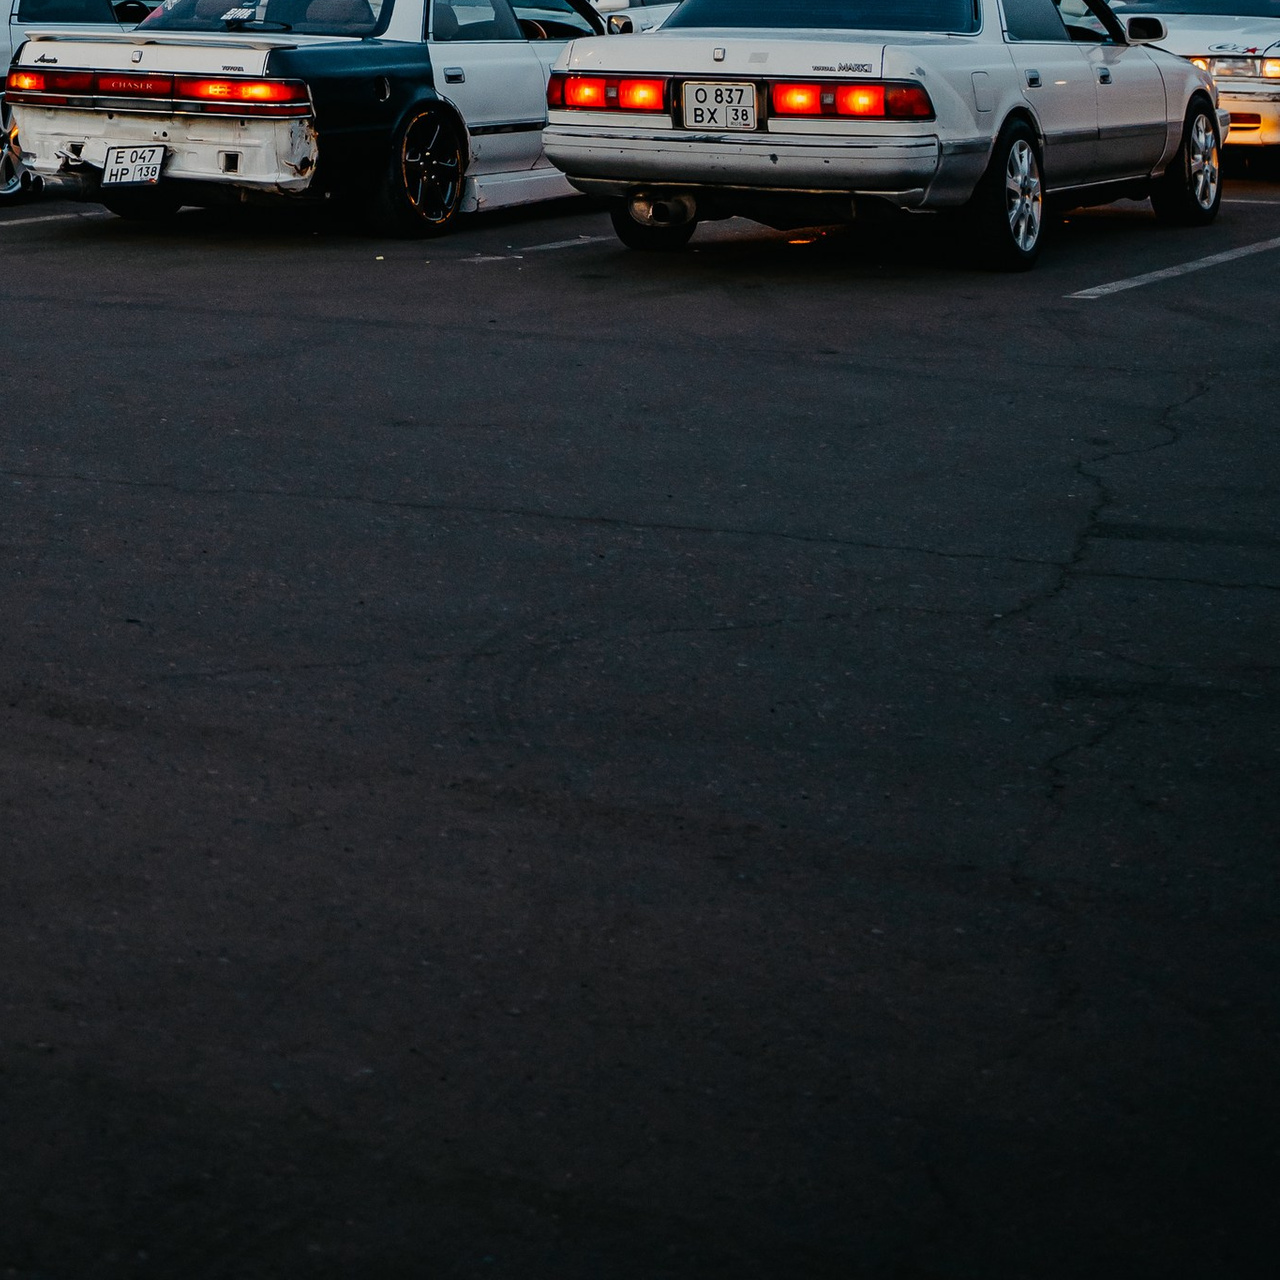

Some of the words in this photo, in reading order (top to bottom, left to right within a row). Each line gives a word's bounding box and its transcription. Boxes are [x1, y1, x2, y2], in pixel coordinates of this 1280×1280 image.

[111, 81, 153, 90] CHASER
[714, 88, 744, 104] 837
[731, 108, 749, 121] 38
[130, 149, 156, 163] 047
[137, 166, 158, 177] 138
